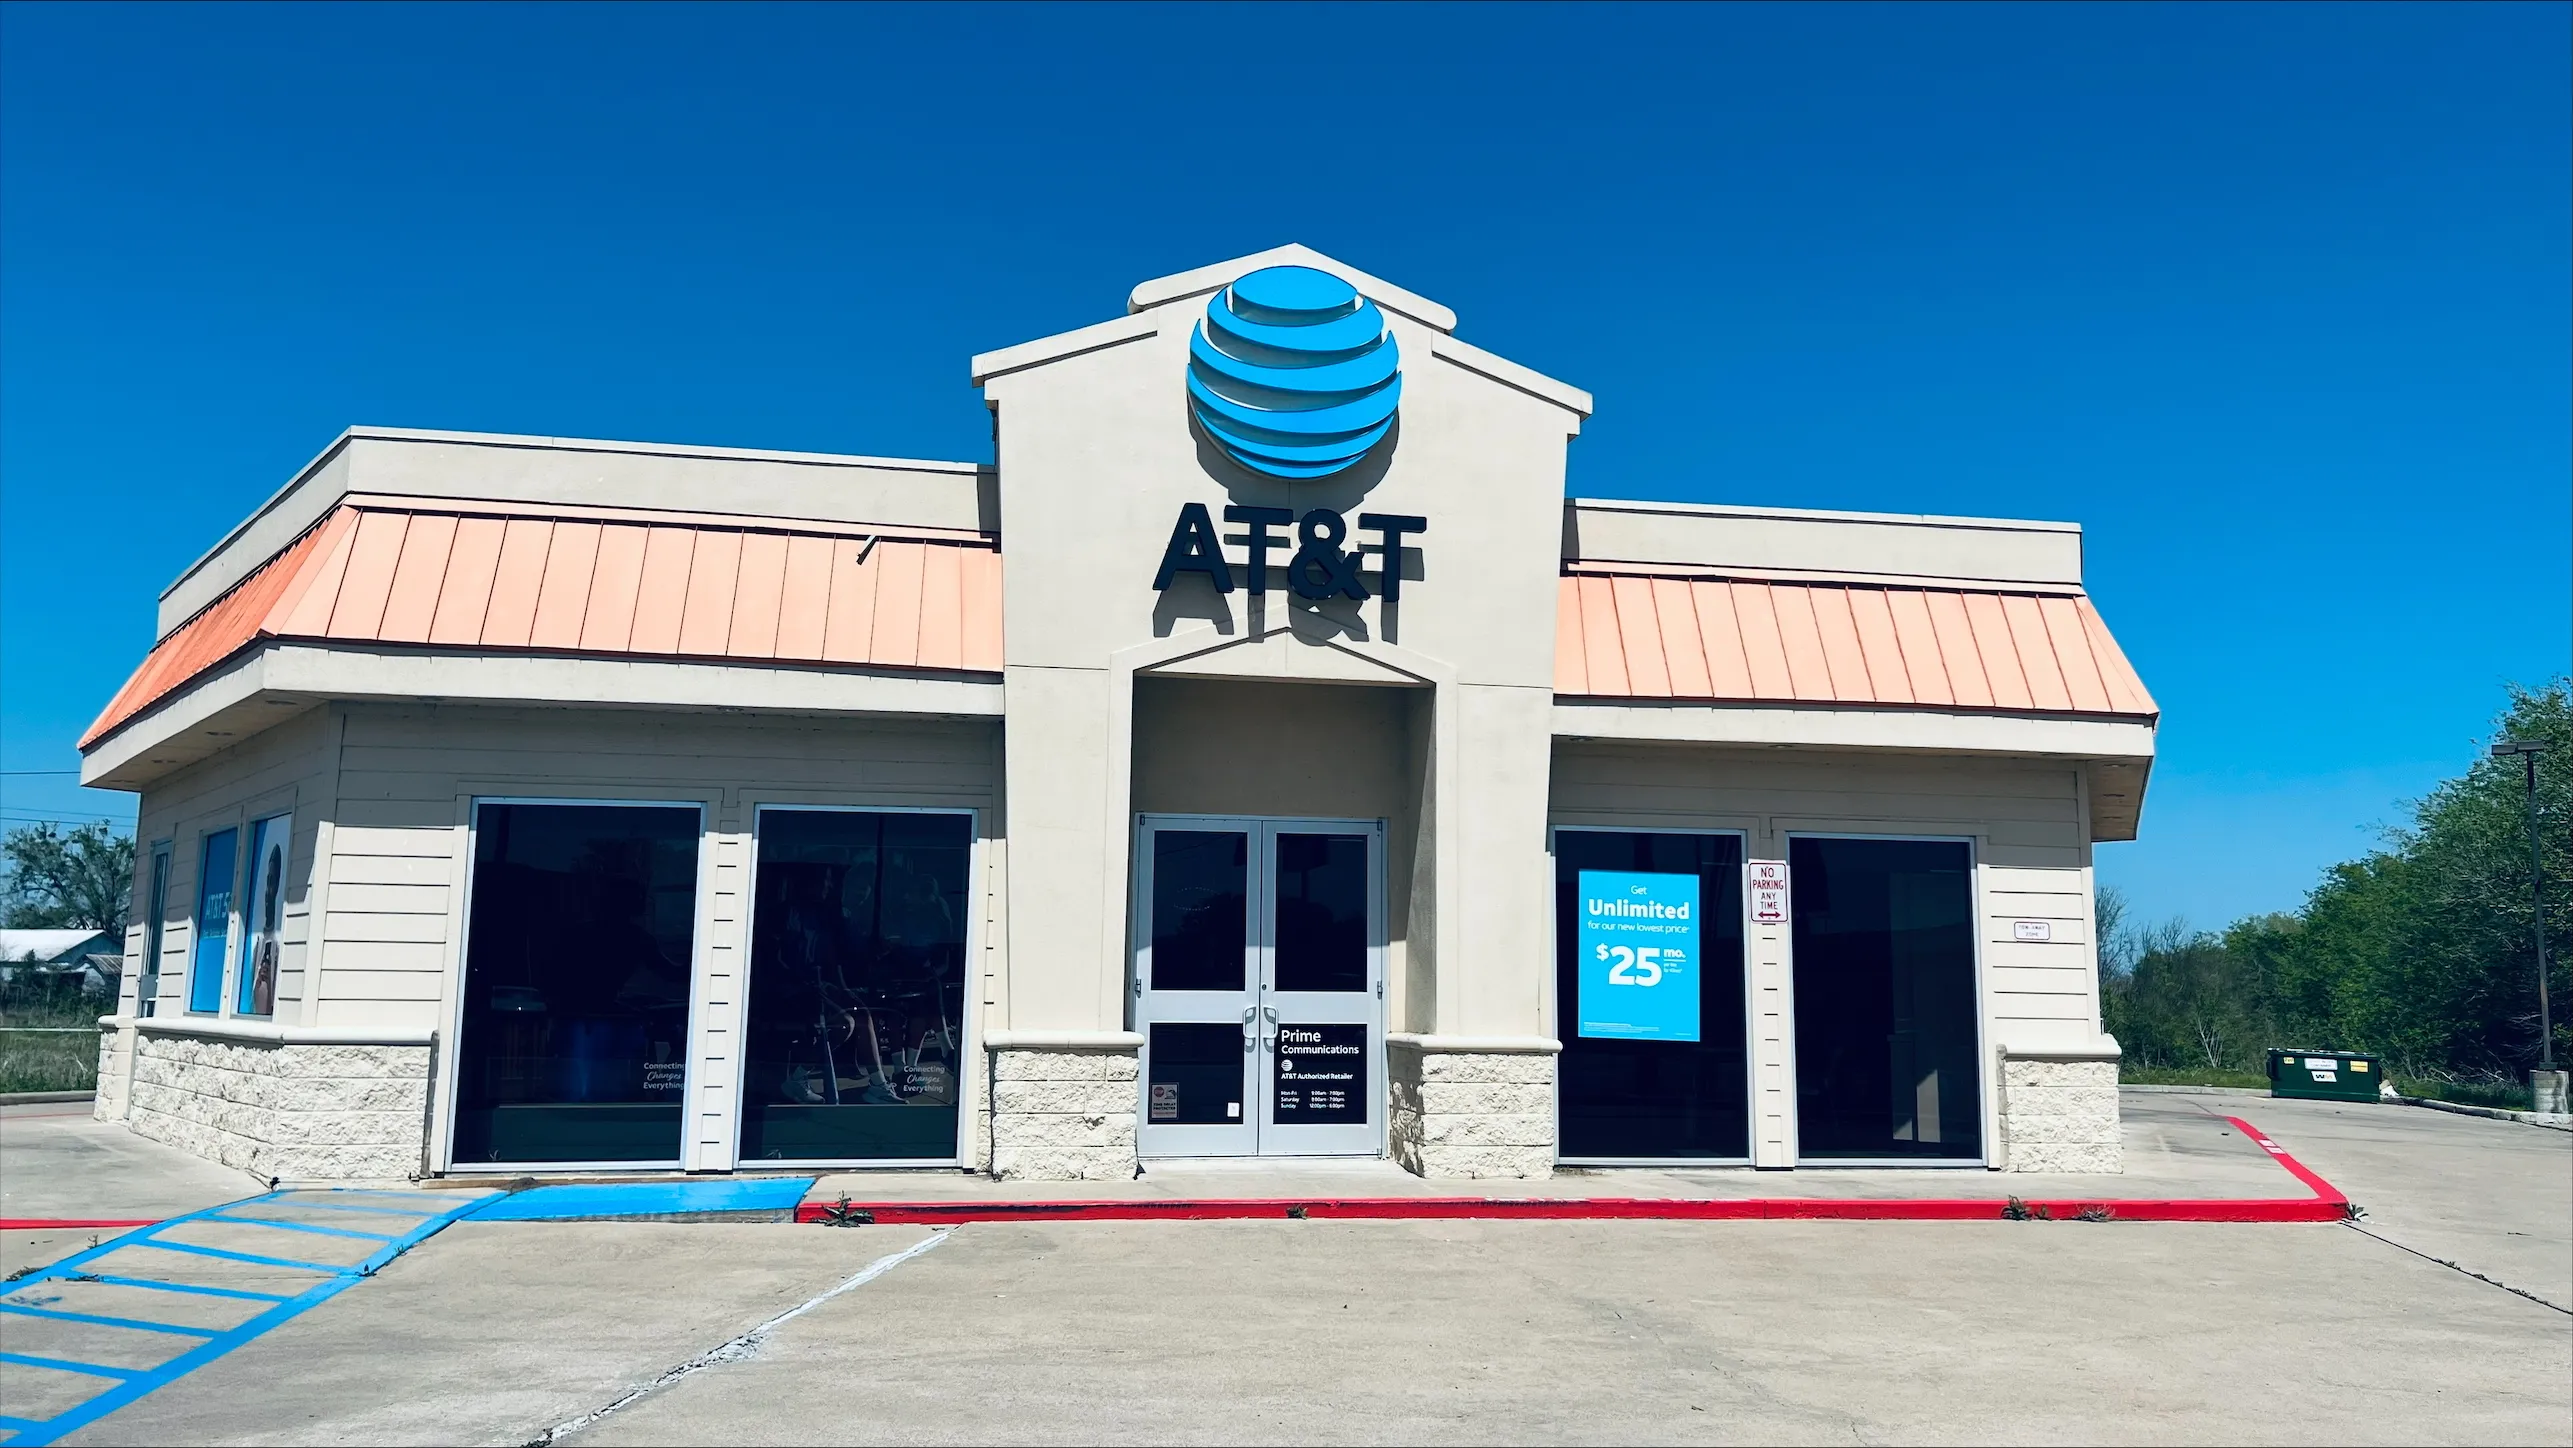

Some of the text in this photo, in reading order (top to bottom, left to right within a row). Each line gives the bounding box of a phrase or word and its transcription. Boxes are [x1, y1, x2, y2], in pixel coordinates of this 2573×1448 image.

[1152, 502, 1428, 602] AT&T
[1760, 867, 1775, 878] NO
[1630, 885, 1648, 895] Get
[1752, 879, 1784, 890] PARKING
[1760, 892, 1777, 901] ANY
[1588, 898, 1690, 920] Unlimited
[1760, 901, 1778, 910] TIME
[1587, 920, 1601, 930] for
[1601, 922, 1616, 931] our
[1617, 923, 1635, 931] new
[1636, 922, 1664, 933] lowest
[1596, 943, 1687, 987] $25 mo.
[1281, 1029, 1322, 1043] Prime
[1281, 1044, 1360, 1055] Communications
[903, 1065, 946, 1075] Connecting
[646, 1071, 682, 1081] Changes
[906, 1074, 941, 1085] Changes
[1280, 1072, 1297, 1080] AT&T
[1297, 1072, 1330, 1080] Authorized
[903, 1084, 944, 1094] Everything
